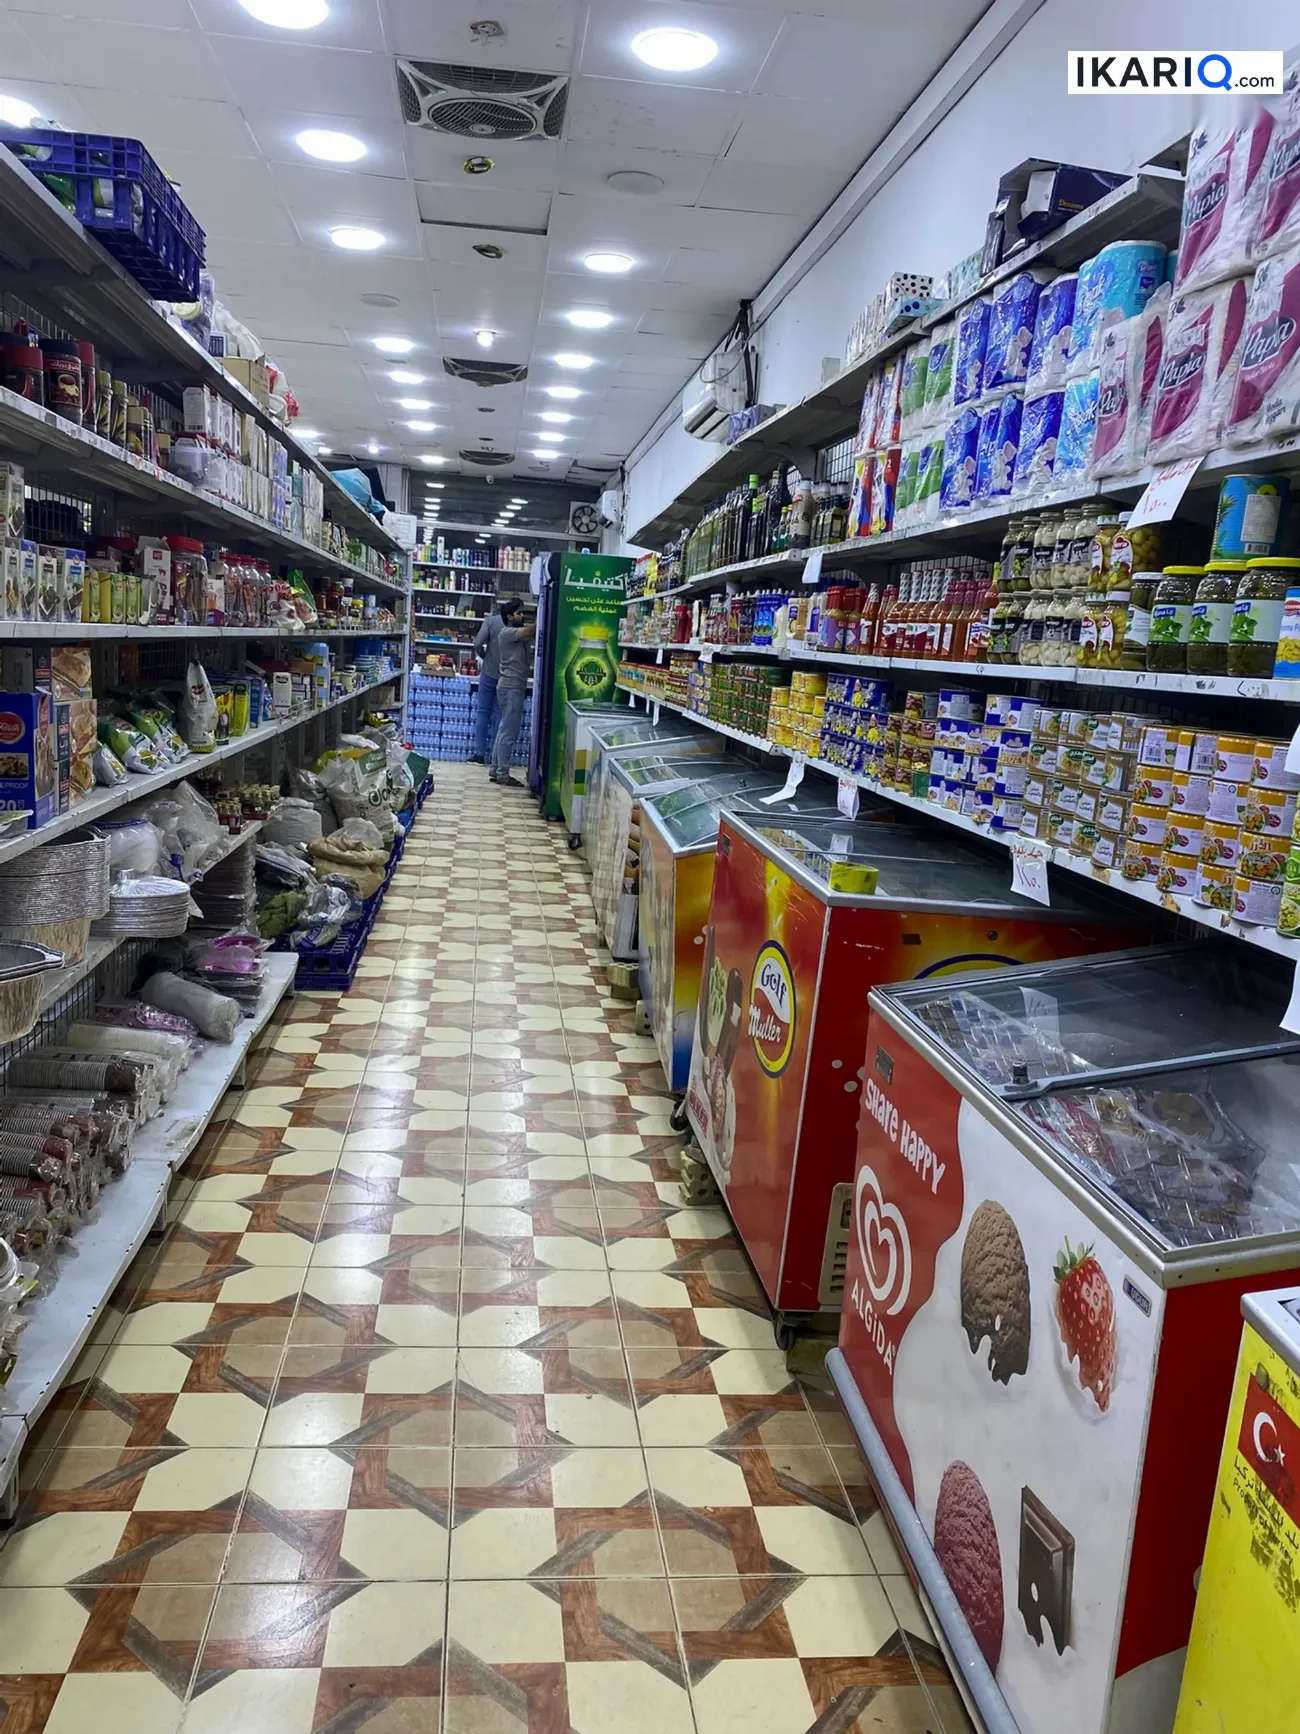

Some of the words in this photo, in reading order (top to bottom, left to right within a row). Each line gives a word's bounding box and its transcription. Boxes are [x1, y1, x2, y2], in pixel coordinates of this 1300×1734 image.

[1244, 316, 1291, 363] Papia
[1163, 352, 1204, 385] Papia
[761, 963, 787, 1009] Golf
